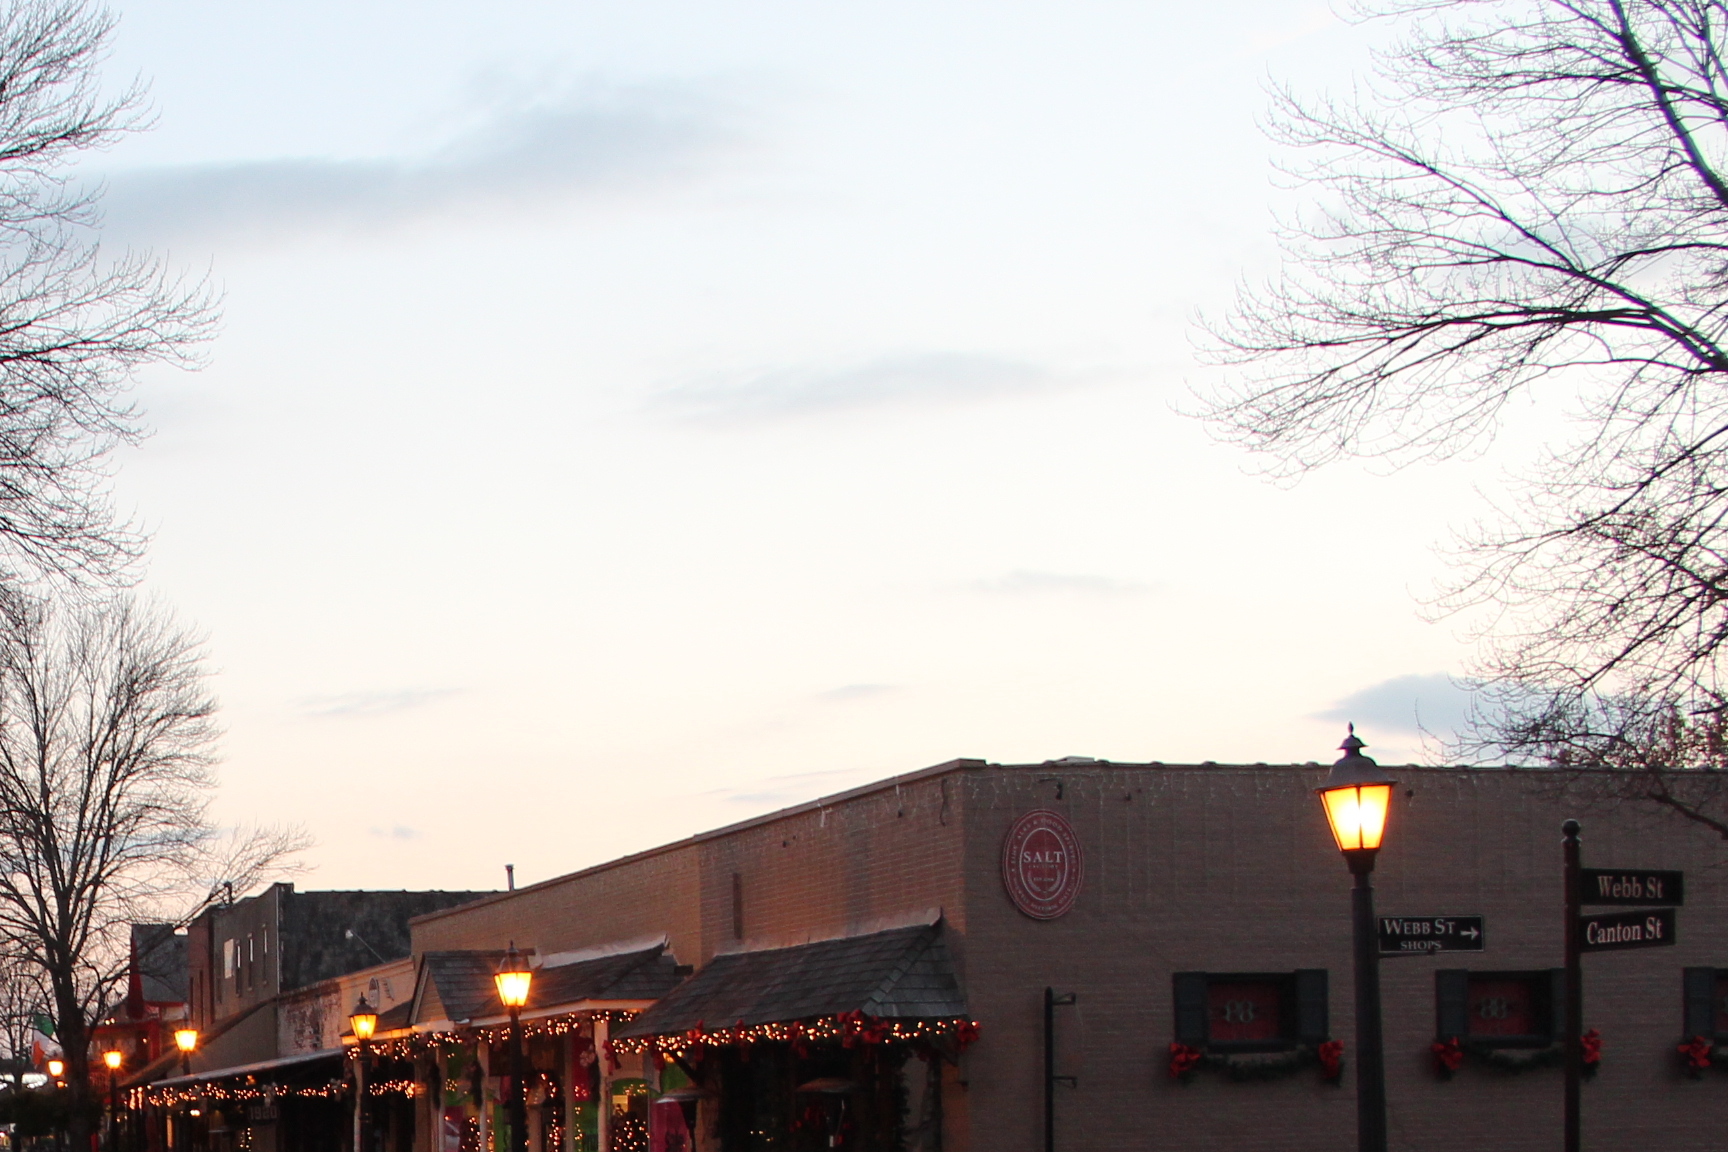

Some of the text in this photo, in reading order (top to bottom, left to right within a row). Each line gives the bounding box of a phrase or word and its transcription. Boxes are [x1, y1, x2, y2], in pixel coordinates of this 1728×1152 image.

[1023, 851, 1063, 863] SALT
[1597, 875, 1663, 899] Webb St
[1586, 916, 1663, 945] Canton St
[1399, 940, 1442, 950] SHOPS
